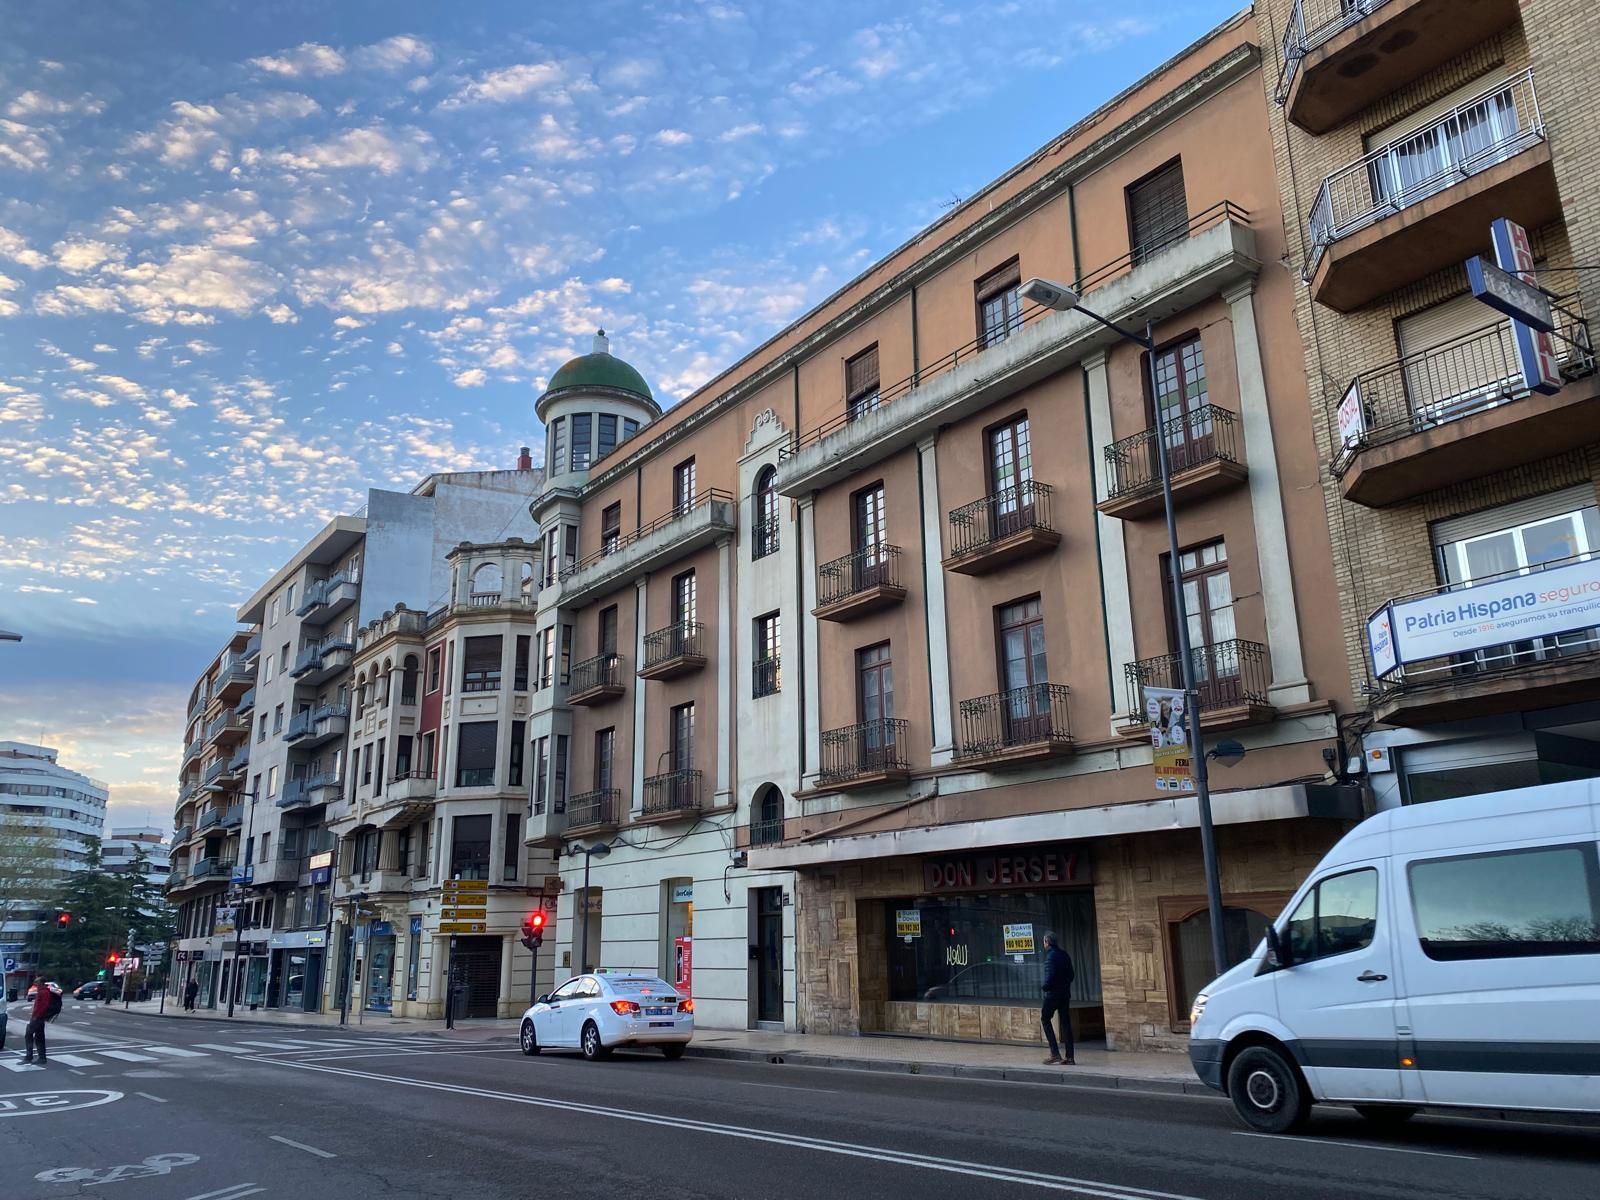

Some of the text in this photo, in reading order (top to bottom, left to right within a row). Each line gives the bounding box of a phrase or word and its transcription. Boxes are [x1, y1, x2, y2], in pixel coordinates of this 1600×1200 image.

[1510, 222, 1561, 385] HOAL
[1406, 608, 1457, 632] Patria
[1458, 592, 1536, 622] Hispana
[1453, 626, 1478, 638] Desde
[1478, 623, 1495, 633] 1916
[1496, 614, 1546, 629] aseguramos
[931, 854, 1077, 888] DON JERSEY
